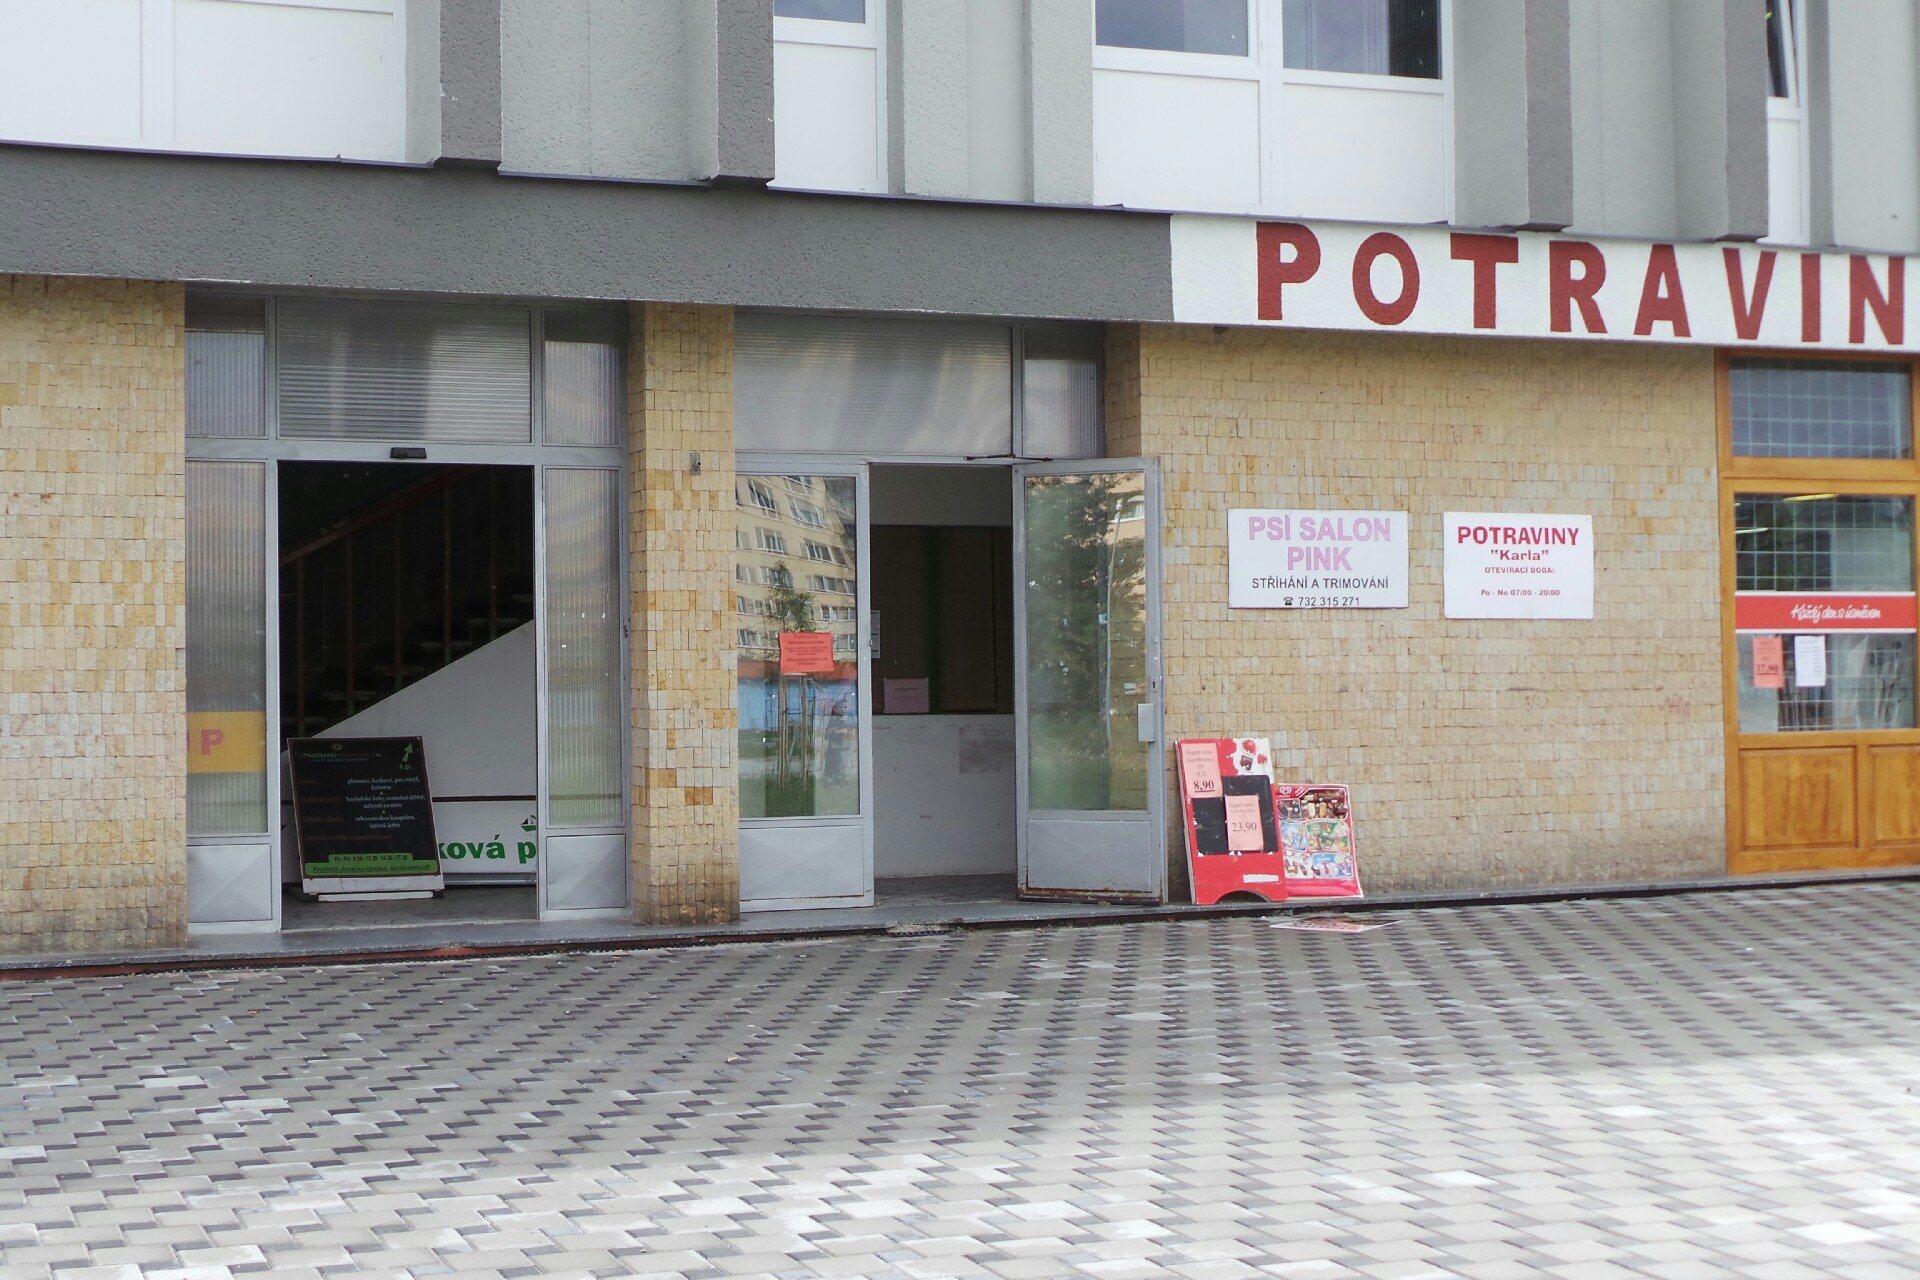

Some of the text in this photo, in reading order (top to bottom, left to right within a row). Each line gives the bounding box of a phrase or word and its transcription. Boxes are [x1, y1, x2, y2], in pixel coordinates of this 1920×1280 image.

[1256, 221, 1905, 345] POTRAVIN
[1299, 517, 1391, 541] SALON
[1457, 525, 1579, 545] POTRAVINY
[1287, 546, 1352, 571] PINK
[1484, 565, 1528, 574] OTEVÍRACÍ
[1252, 575, 1389, 589] STŘÍHÁNÍ A TRIMOVÁNÍ
[1298, 596, 1360, 607] 732 315 271
